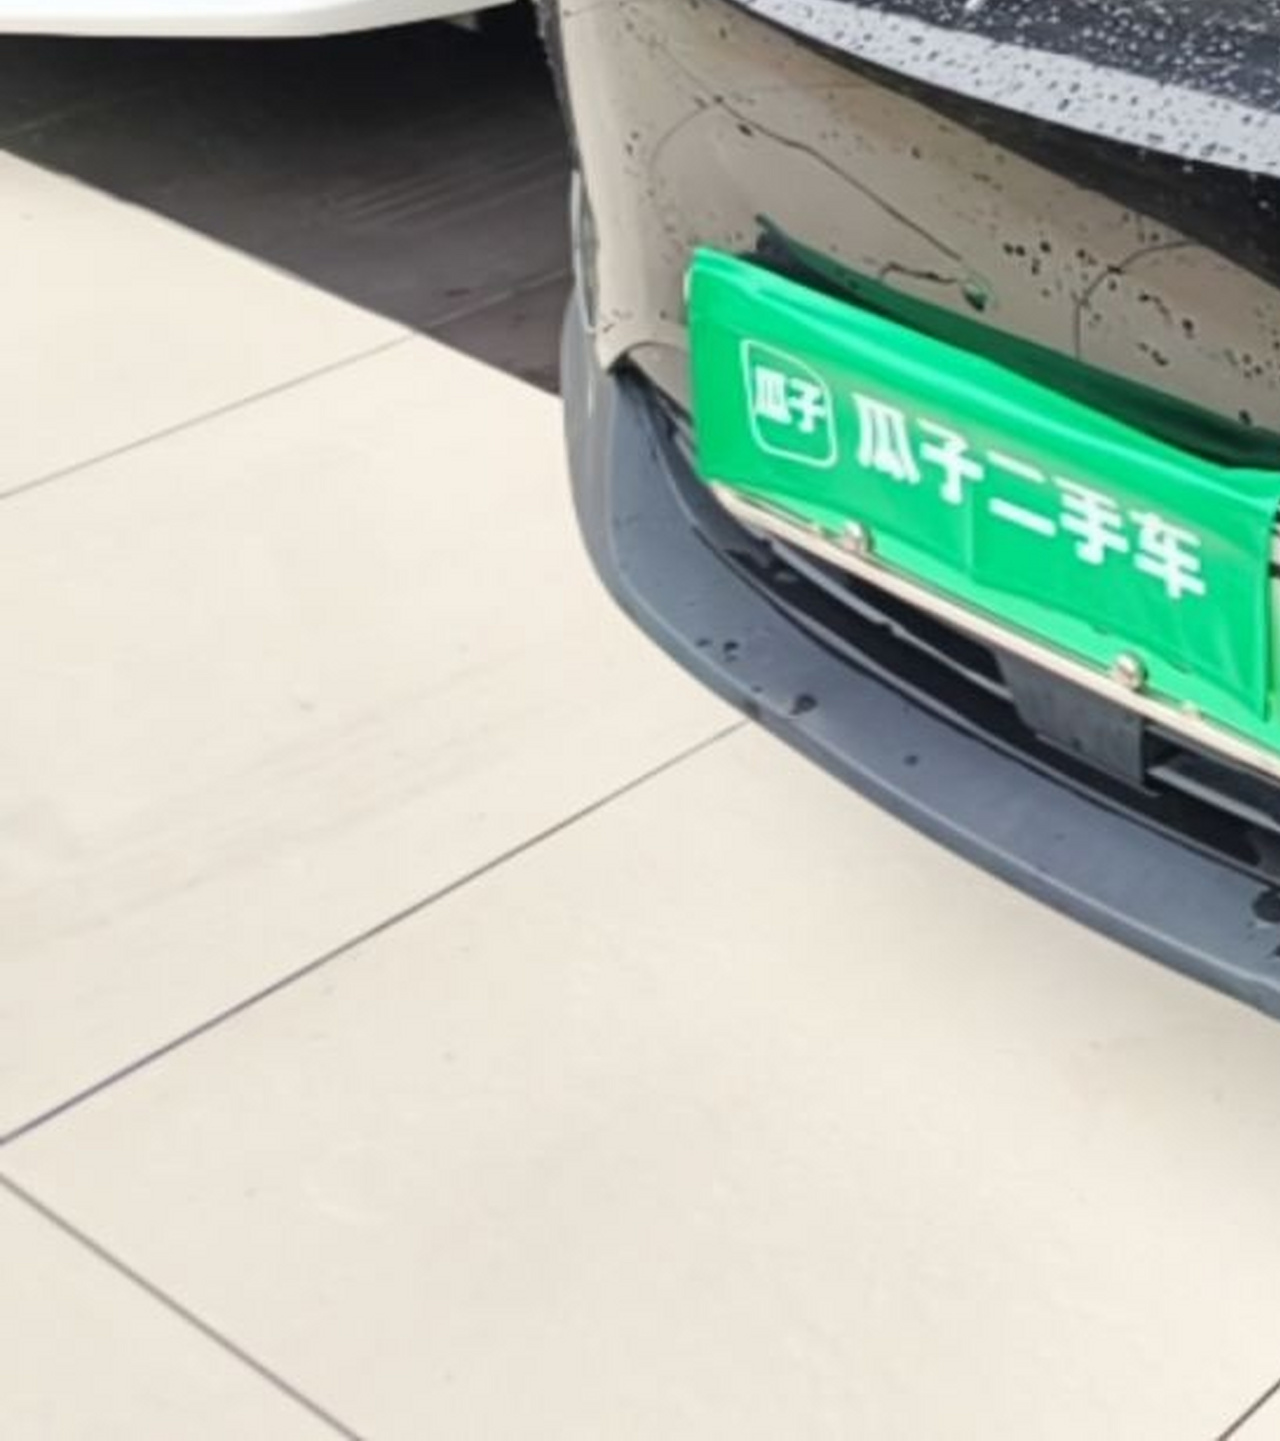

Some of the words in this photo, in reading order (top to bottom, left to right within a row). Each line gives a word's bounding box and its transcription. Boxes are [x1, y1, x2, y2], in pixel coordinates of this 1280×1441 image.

[754, 367, 827, 433] 瓜子
[852, 391, 1205, 600] 瓜子二手车
